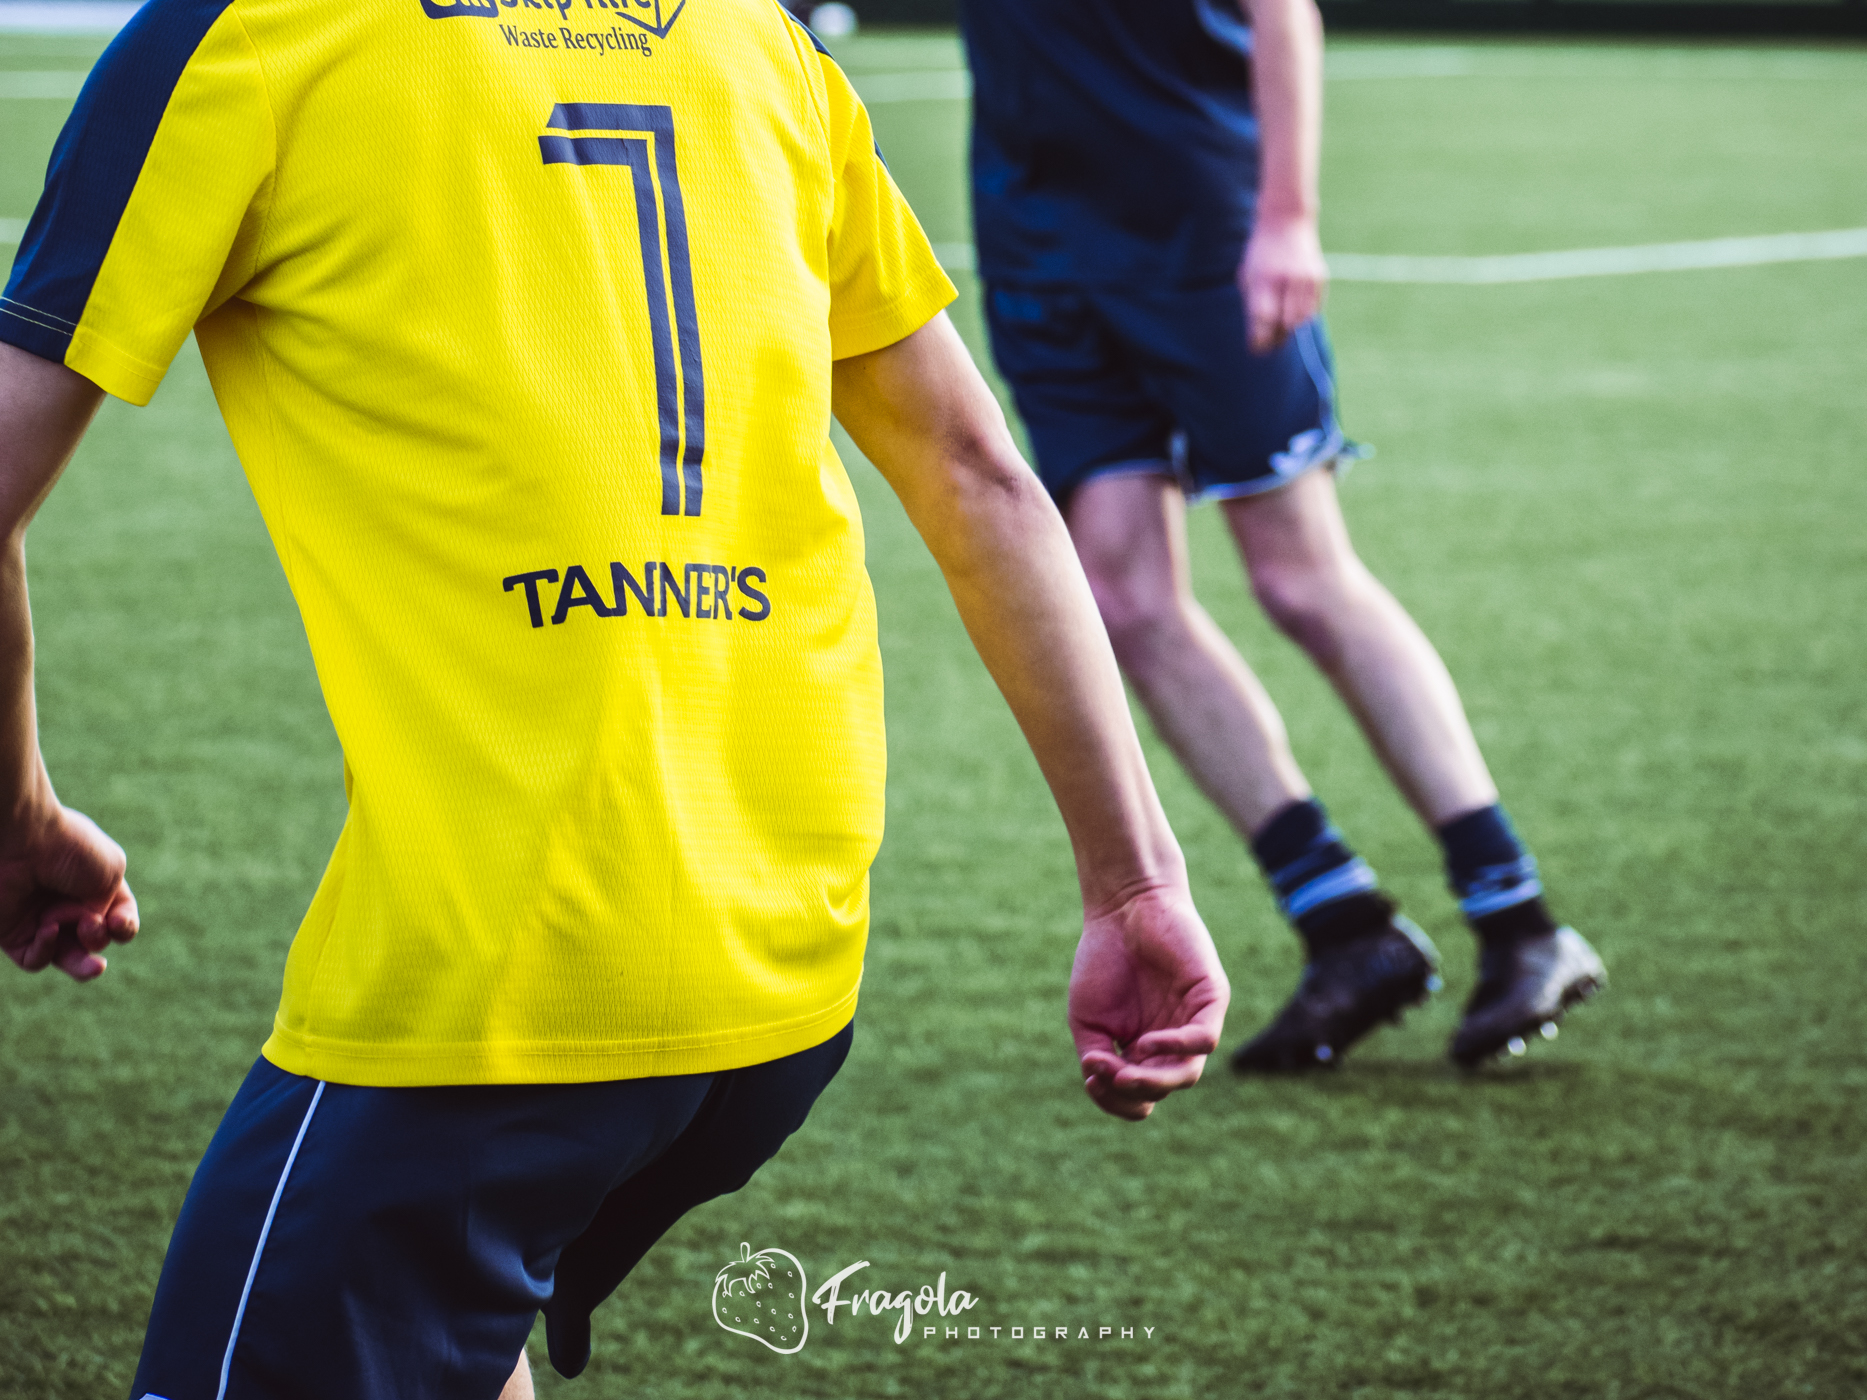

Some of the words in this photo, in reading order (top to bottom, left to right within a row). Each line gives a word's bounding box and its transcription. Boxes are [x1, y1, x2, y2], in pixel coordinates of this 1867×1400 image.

[498, 24, 559, 49] Waste
[558, 26, 653, 57] Recycling
[502, 561, 771, 629] TANNER'S
